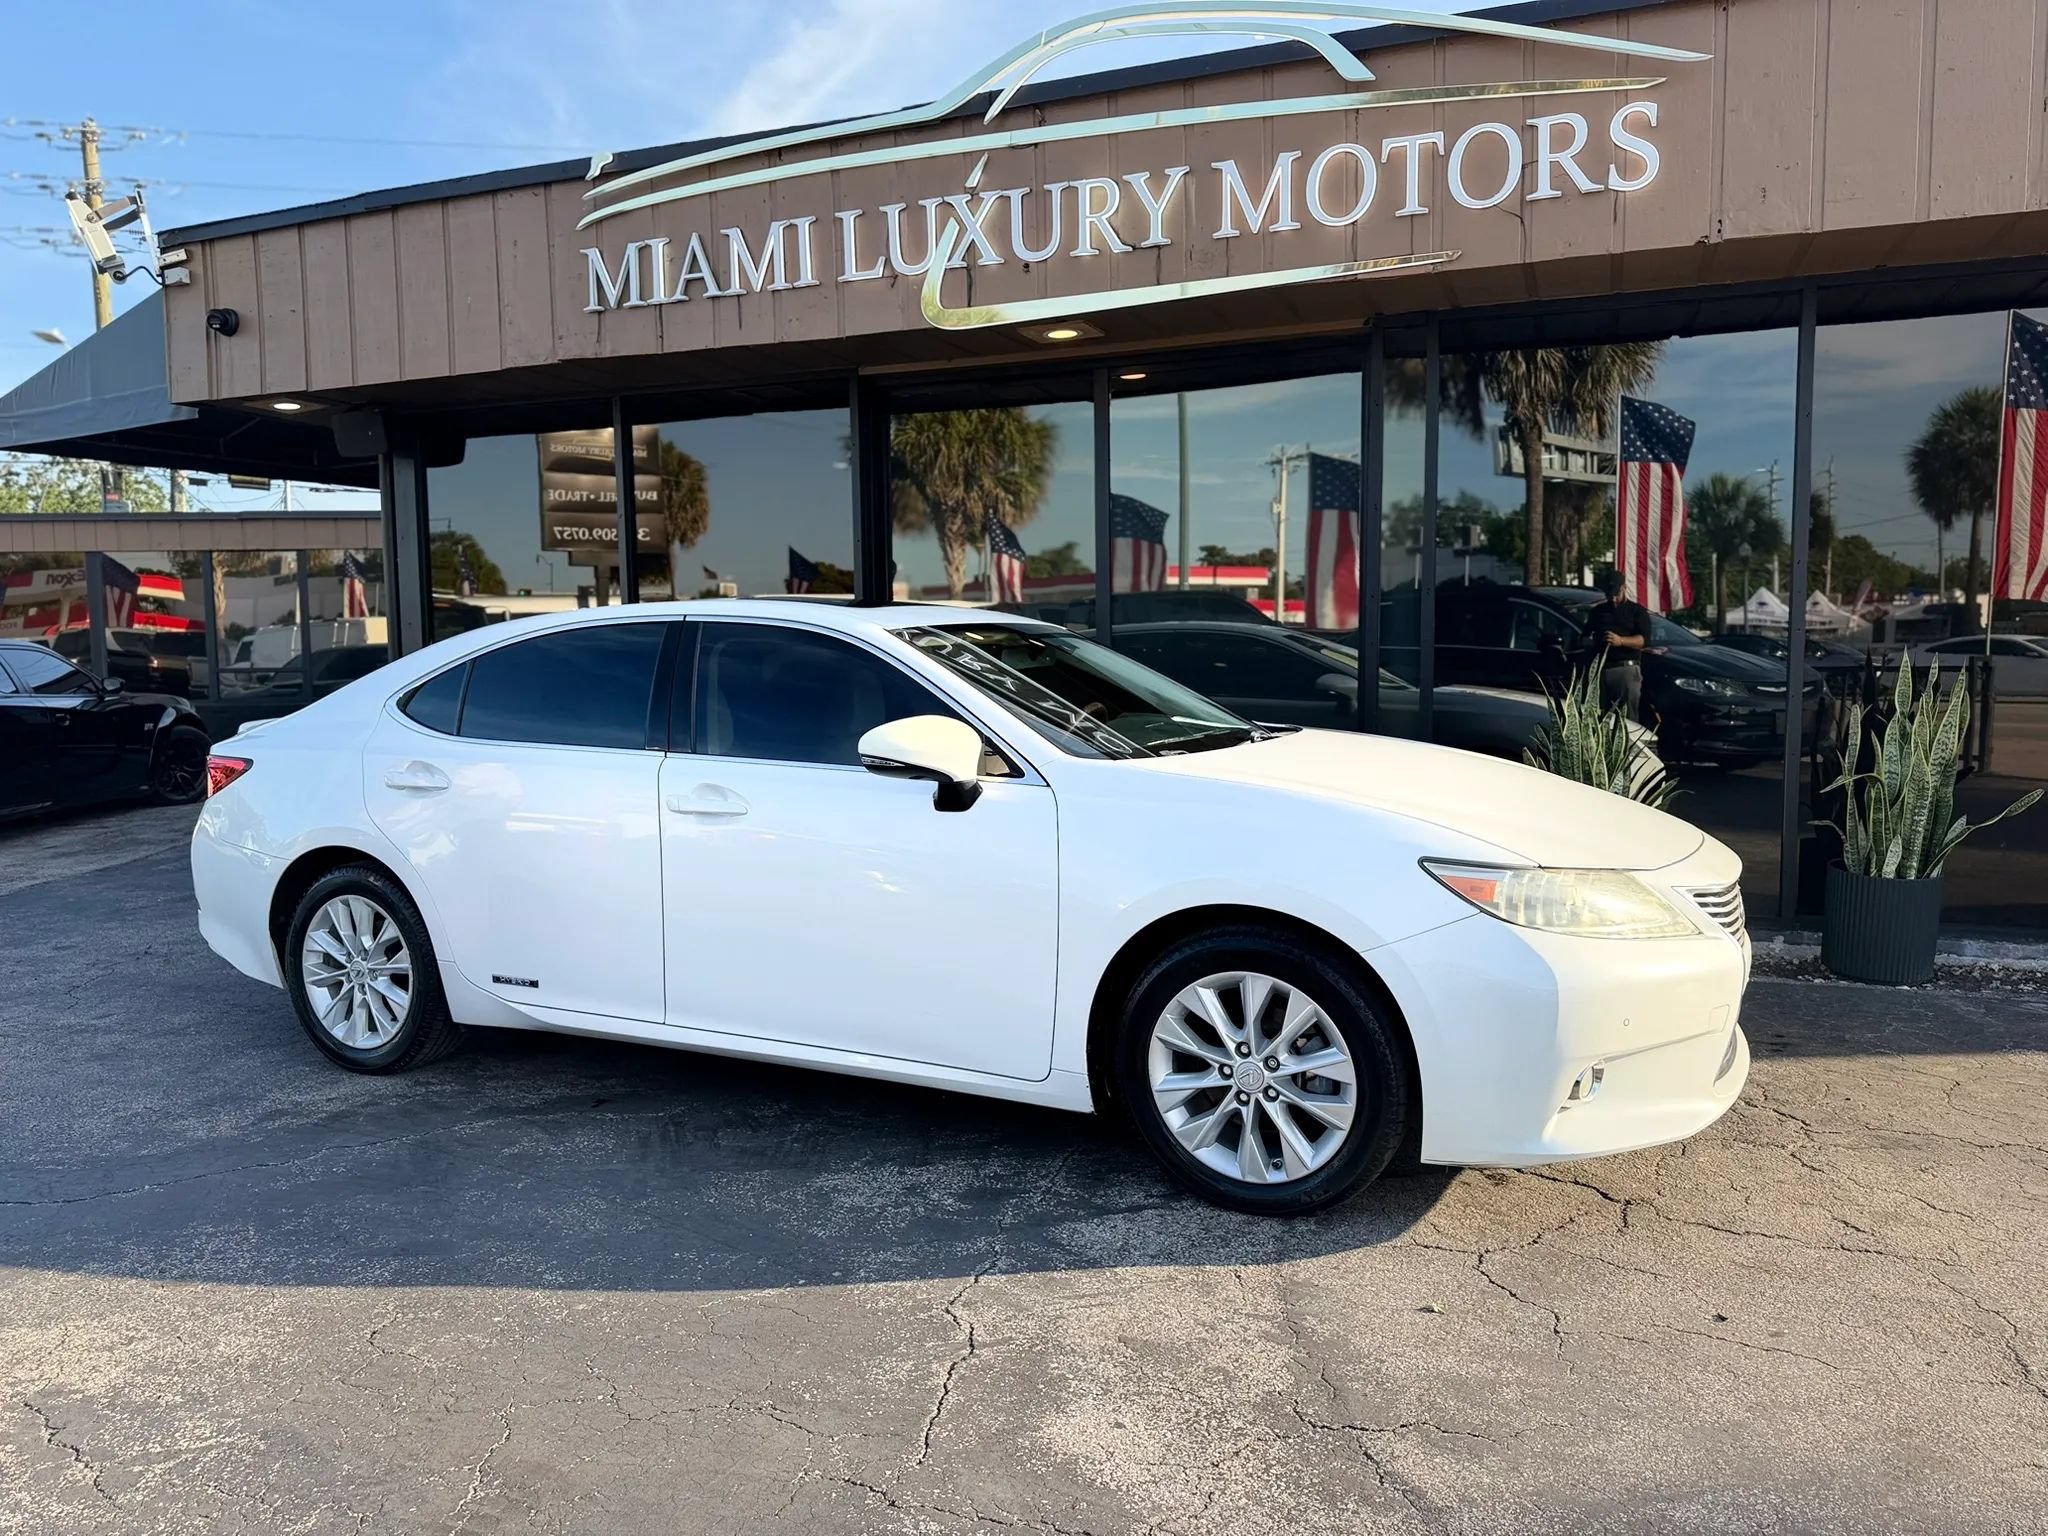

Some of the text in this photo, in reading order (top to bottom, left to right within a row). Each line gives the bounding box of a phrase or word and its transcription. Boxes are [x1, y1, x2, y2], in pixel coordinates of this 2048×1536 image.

[579, 101, 1661, 313] MIAMI LUXURY MOTORS
